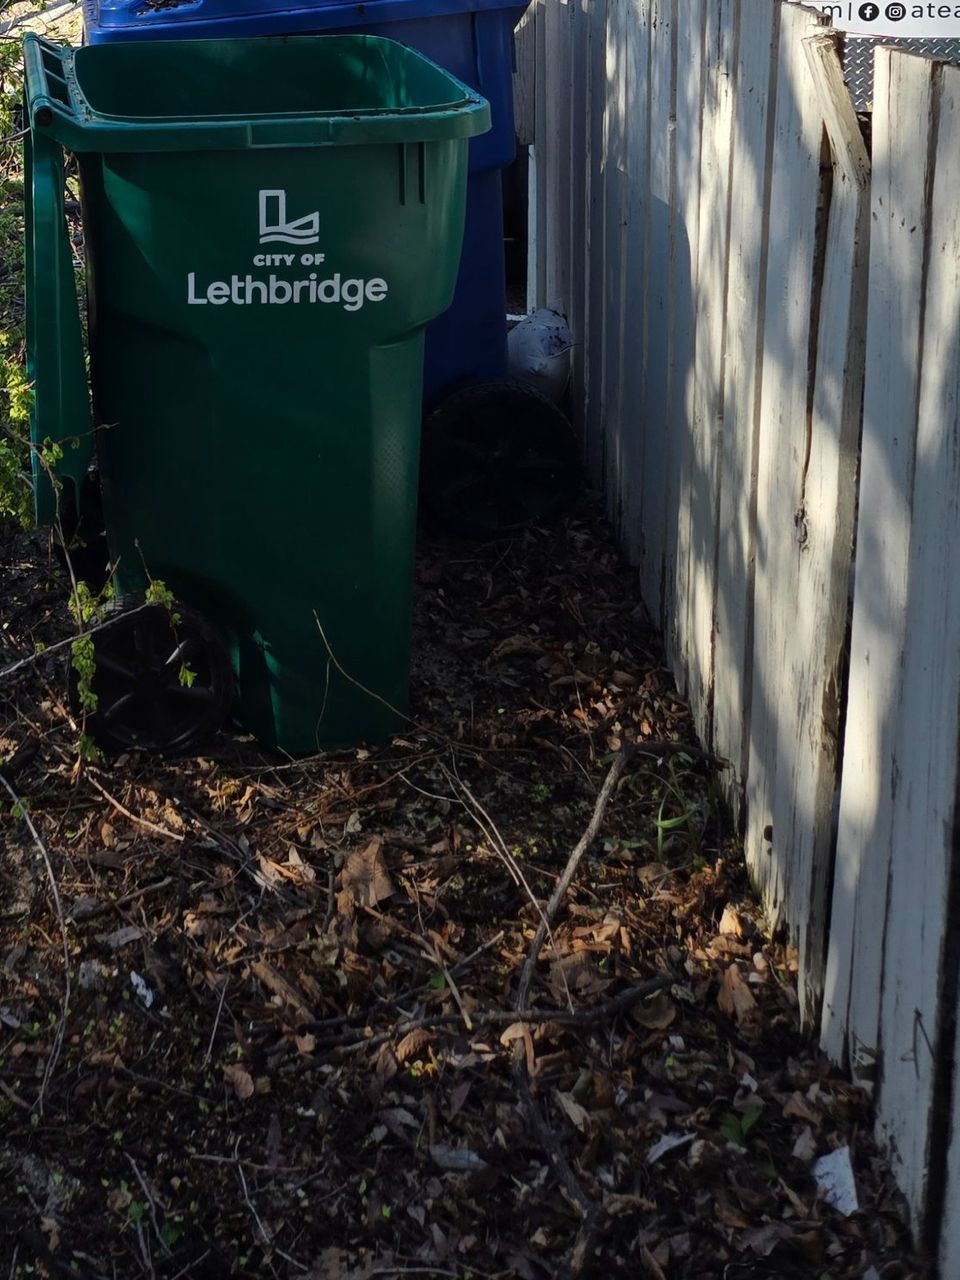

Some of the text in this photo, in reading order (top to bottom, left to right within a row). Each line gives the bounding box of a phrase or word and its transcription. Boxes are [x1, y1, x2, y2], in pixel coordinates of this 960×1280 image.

[252, 253, 326, 267] CITY OF
[187, 271, 389, 312] Lethbridge
